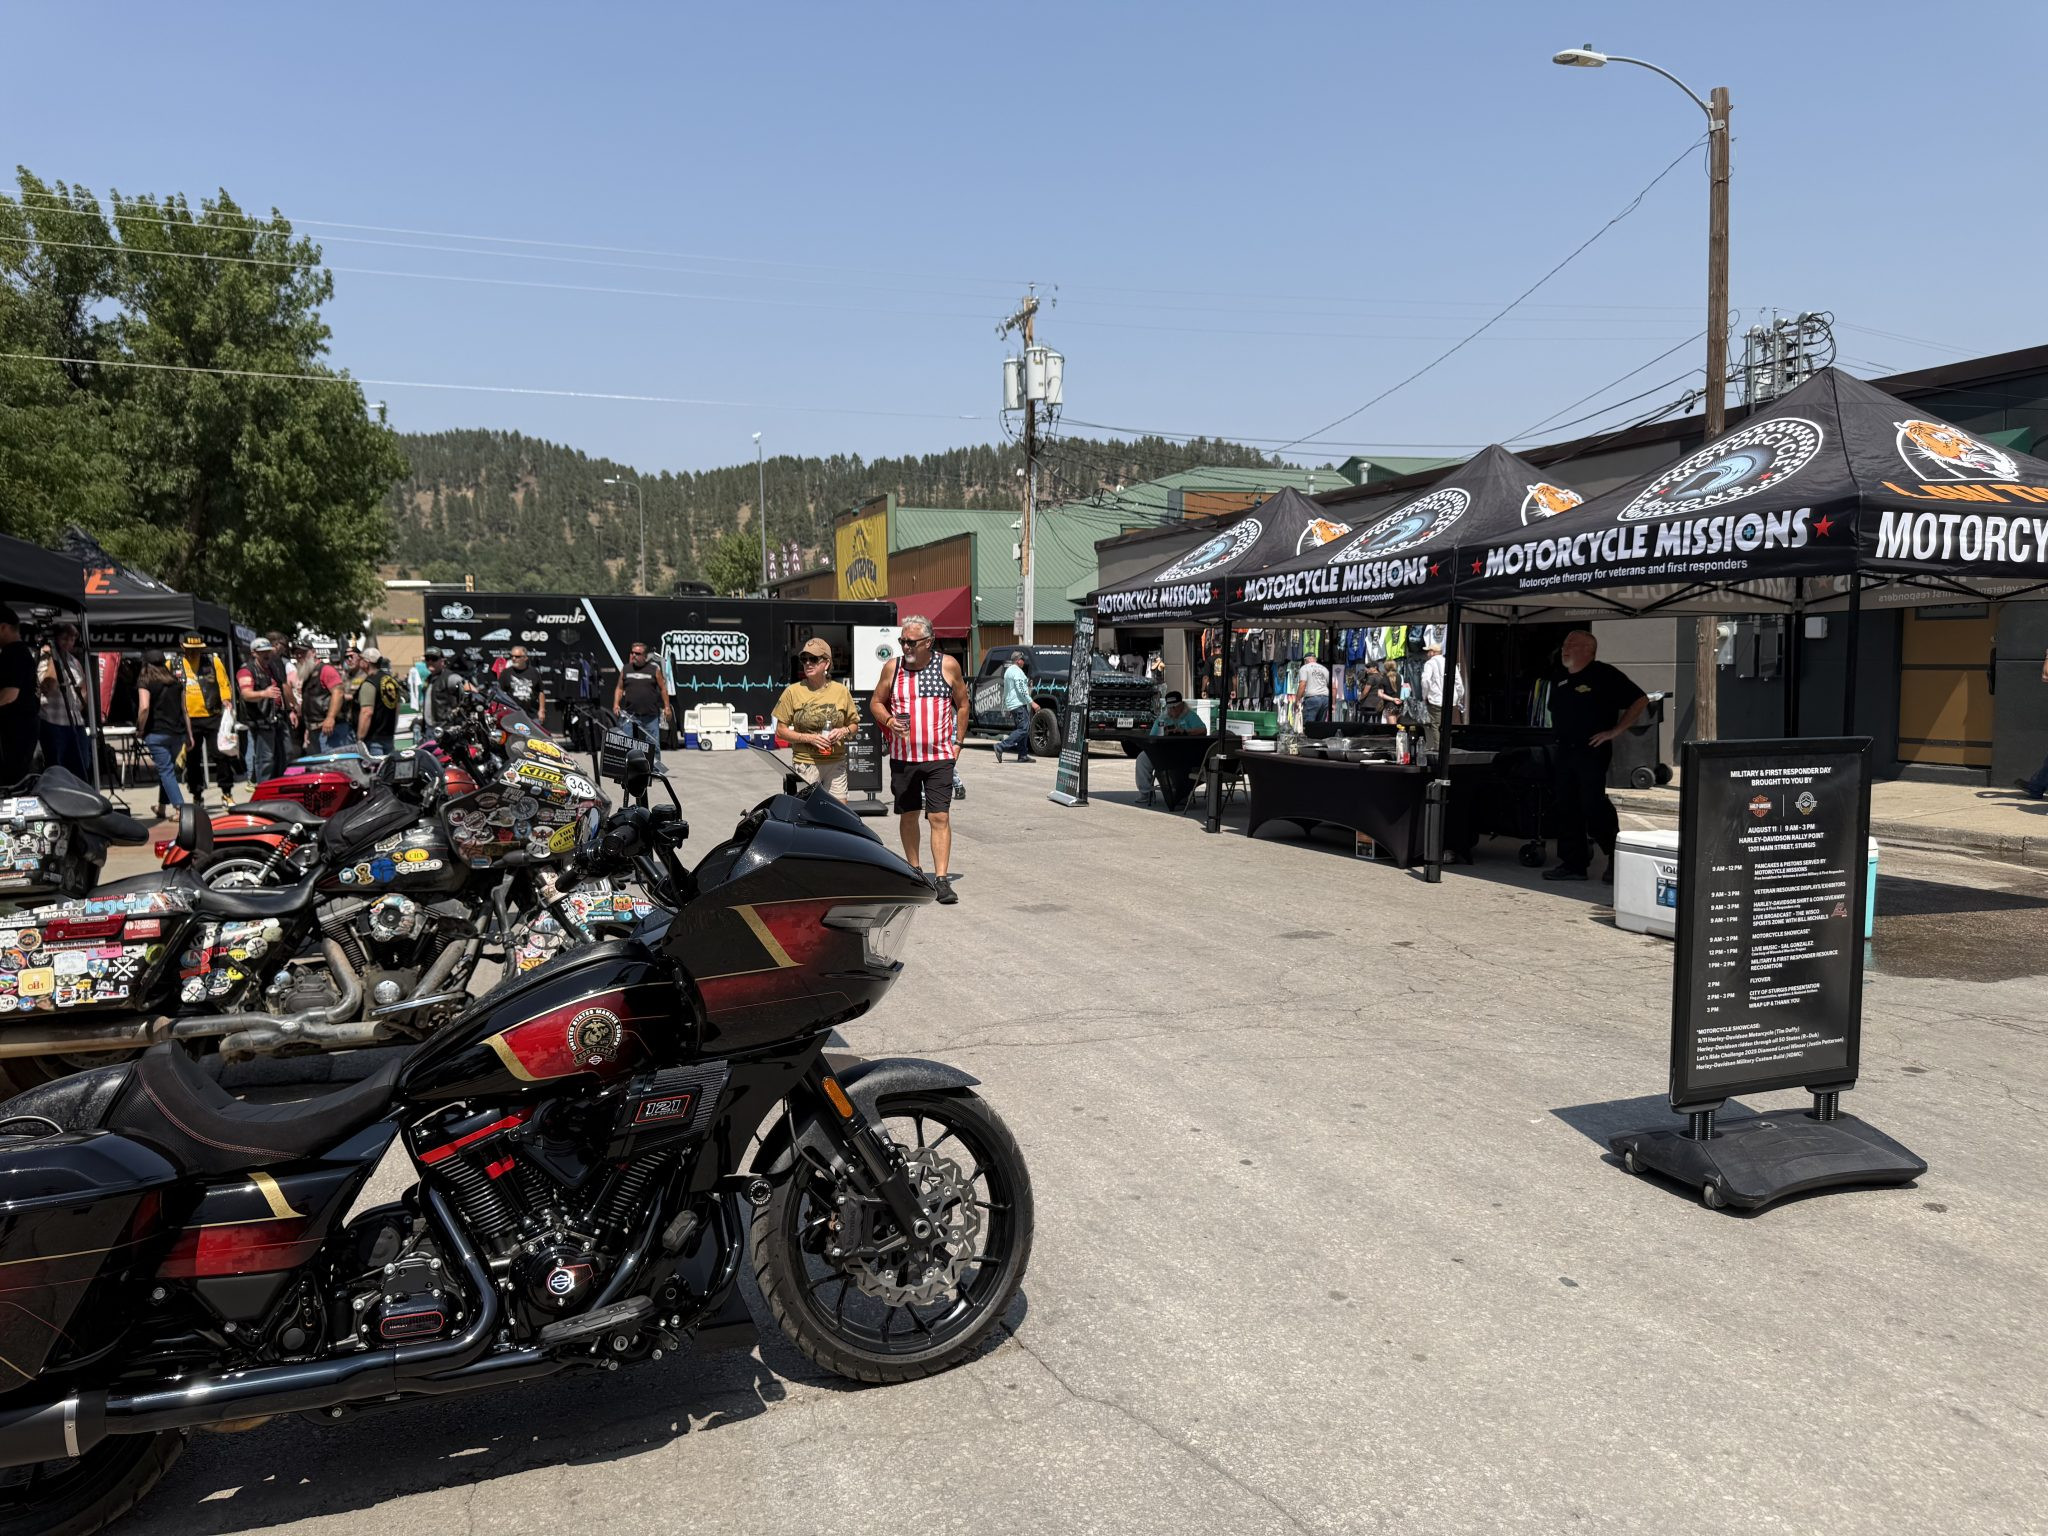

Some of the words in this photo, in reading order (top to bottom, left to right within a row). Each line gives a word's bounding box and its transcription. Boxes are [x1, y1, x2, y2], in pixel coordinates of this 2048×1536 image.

[1672, 434, 1796, 482] MOTORCYCLE
[1484, 525, 1649, 578] MOTORCYCLE
[1654, 507, 1811, 557] MISSIONS
[1244, 567, 1338, 602] MOTORCYCLE
[1342, 556, 1428, 592] MISSIONS
[1519, 573, 1561, 589] Motorcycle
[1562, 571, 1593, 586] therapy
[1594, 568, 1607, 580] for
[1608, 565, 1646, 578] veterans
[1647, 563, 1665, 575] and
[1667, 561, 1687, 573] first
[1689, 558, 1748, 573] responders
[1098, 589, 1158, 614] MOTORCYCLE
[1160, 582, 1211, 608] MISSIONS
[1263, 601, 1288, 611] Motorcycle
[1288, 599, 1307, 610] therapy
[1316, 596, 1338, 606] veterans
[1339, 595, 1350, 604] and
[1350, 594, 1362, 602] first
[1362, 592, 1394, 602] responders
[672, 634, 738, 644] MOTORCYCLE
[665, 644, 746, 662] MISSIONS
[570, 778, 592, 794] 343
[1739, 835, 1790, 843] HARLEY-DAVIDSON
[1658, 886, 1666, 897] 7
[573, 1010, 593, 1026] STATES
[596, 1009, 619, 1024] MARINE
[646, 1100, 681, 1114] 121
